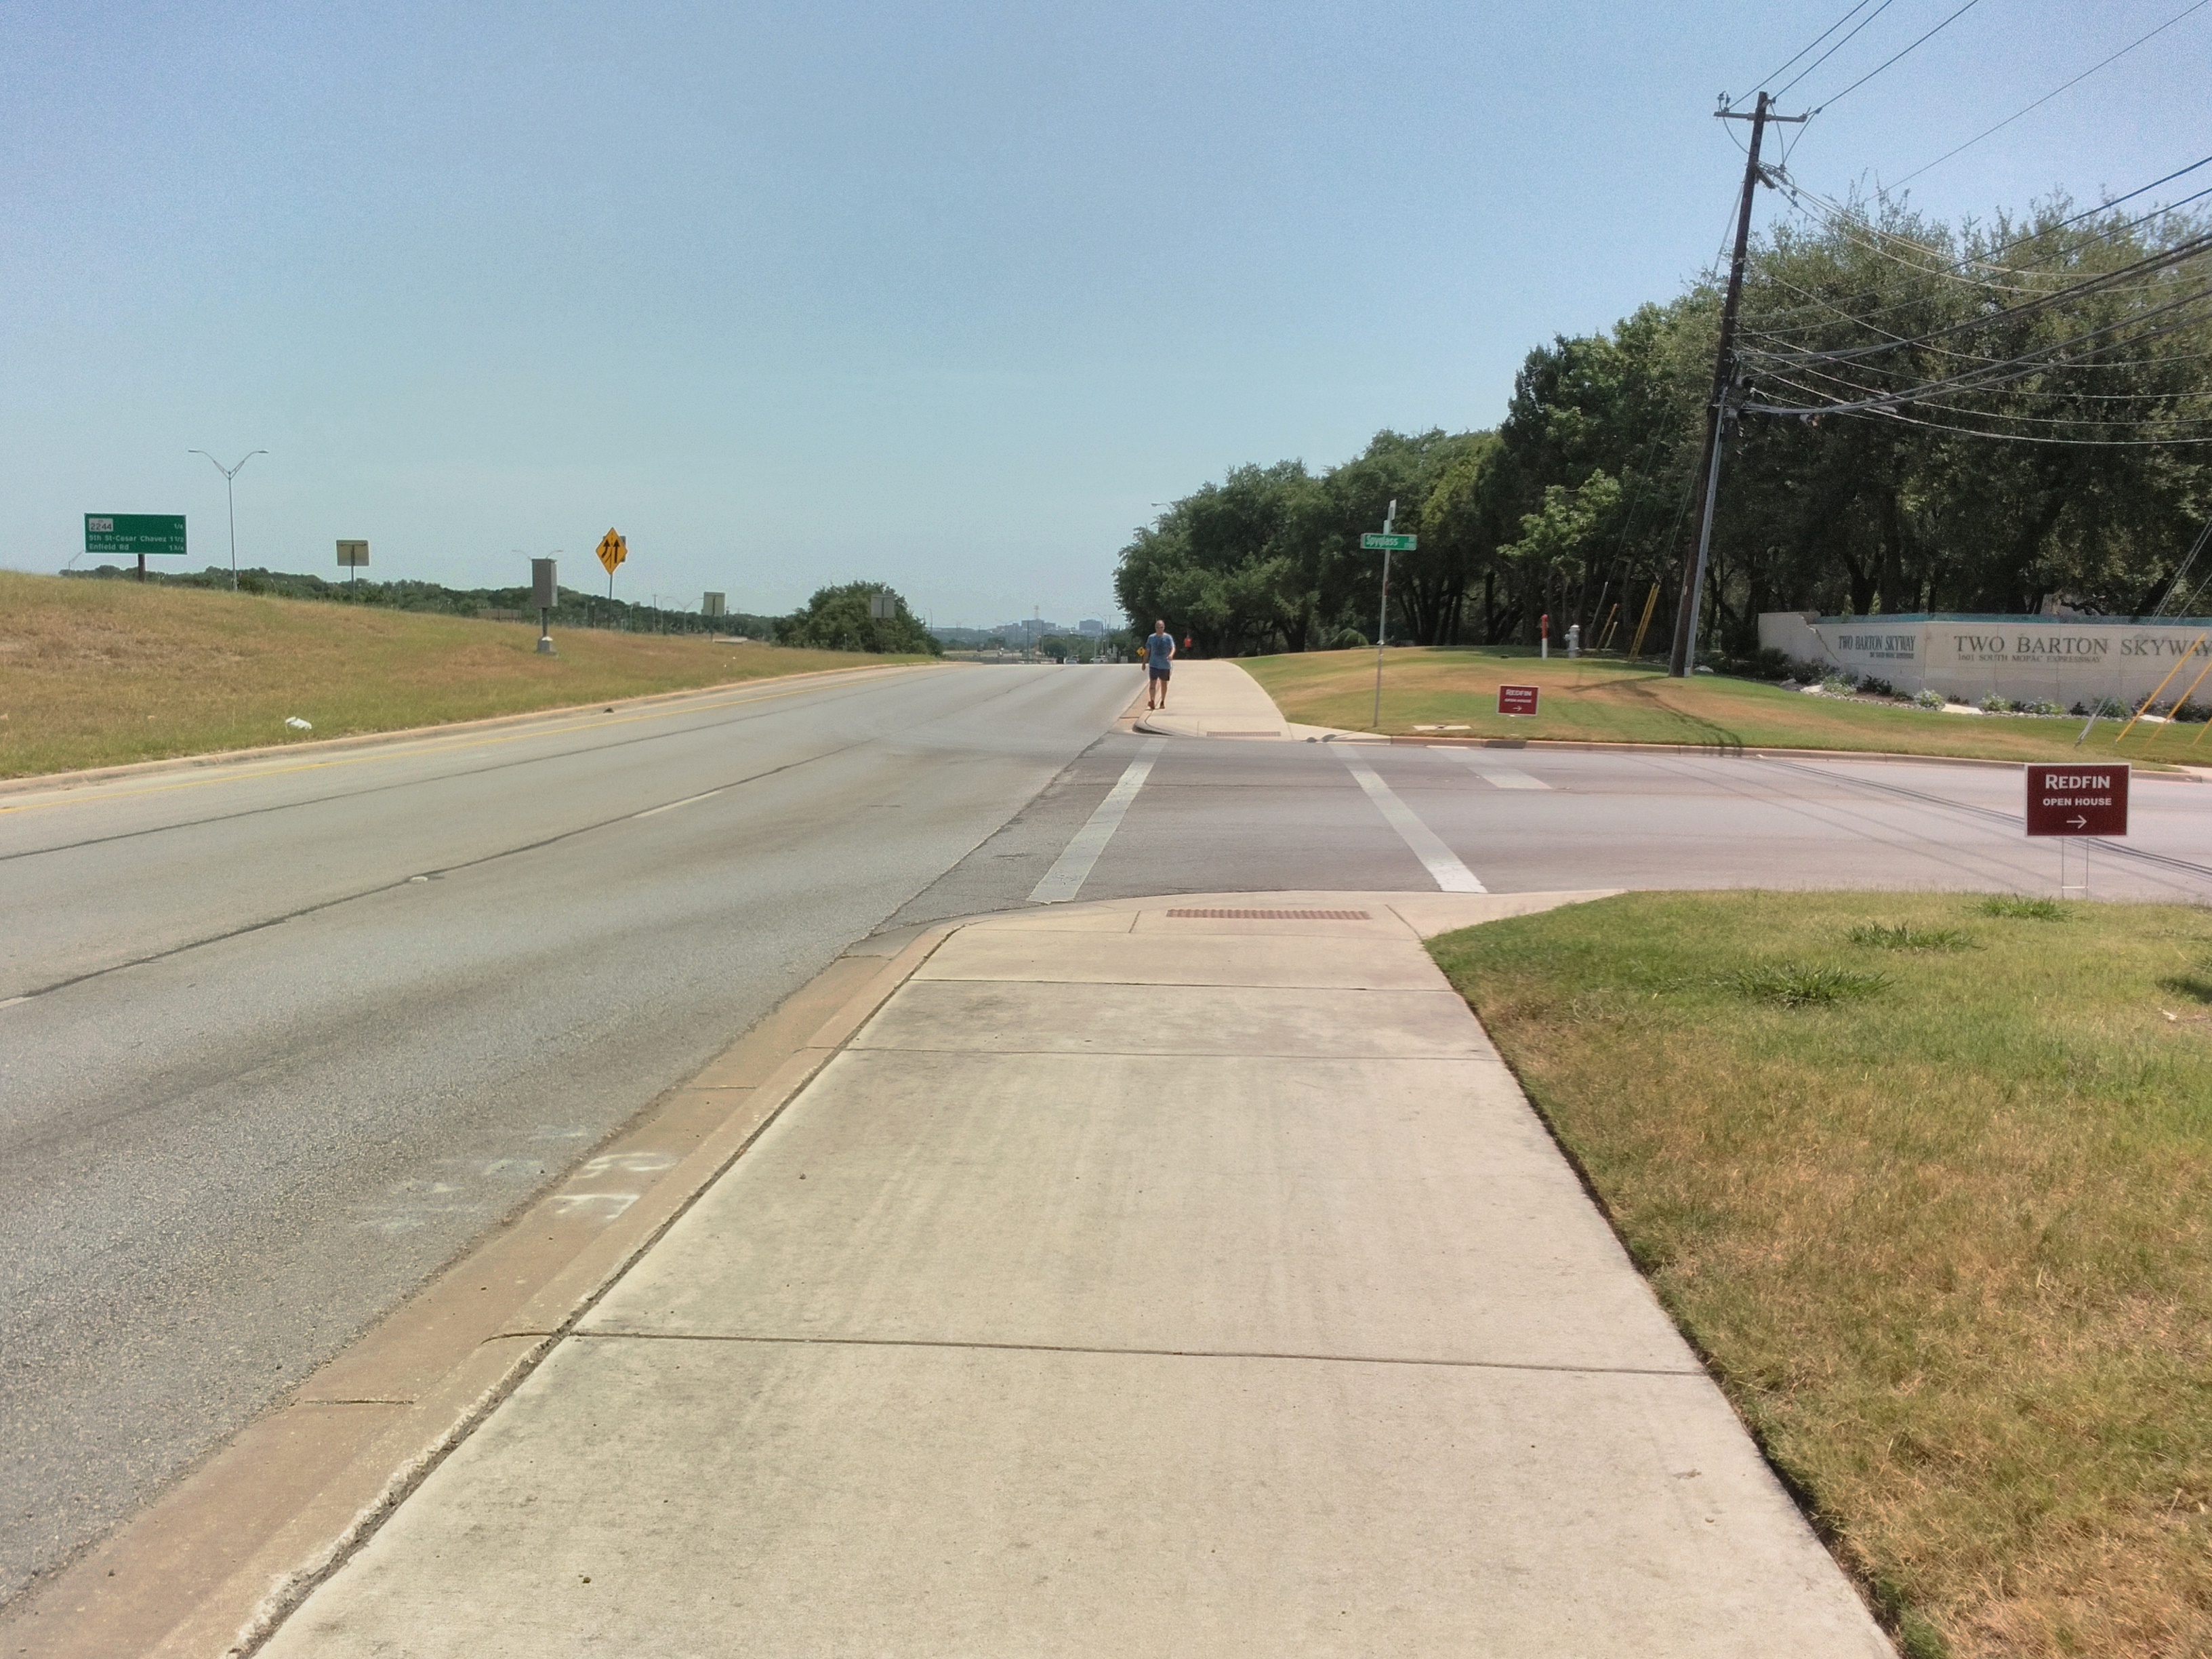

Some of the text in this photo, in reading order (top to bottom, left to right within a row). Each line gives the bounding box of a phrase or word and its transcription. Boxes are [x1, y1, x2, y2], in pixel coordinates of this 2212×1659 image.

[1366, 535, 1398, 547] Spyglass
[1839, 636, 1916, 651] TWO BARTON SKYWAY
[1954, 636, 2005, 653] TWO
[2015, 636, 2110, 655] BARTON
[2045, 774, 2110, 790] REDFIN
[2043, 798, 2112, 806] OPEN HOUSE
